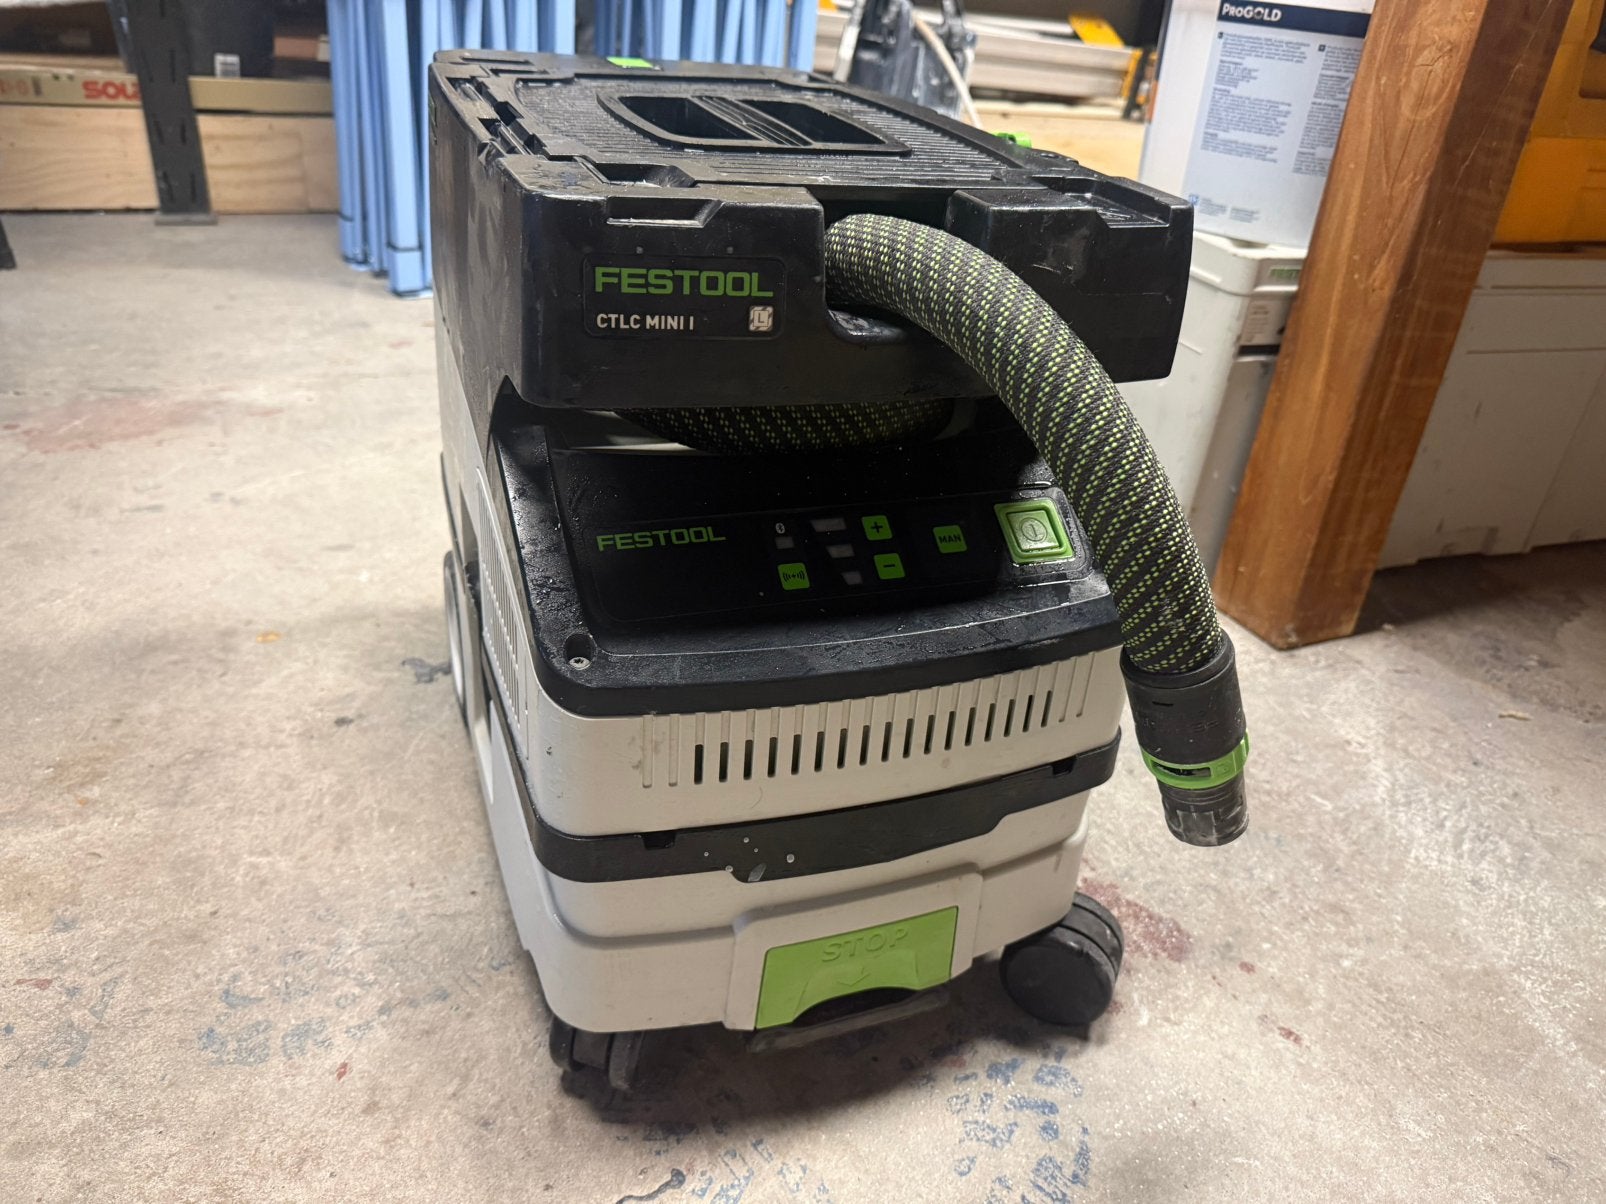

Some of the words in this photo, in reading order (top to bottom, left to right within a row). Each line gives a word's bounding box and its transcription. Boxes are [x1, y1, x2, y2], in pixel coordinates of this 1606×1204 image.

[595, 266, 774, 297] FESTOOL
[596, 313, 641, 329] CTLC
[645, 314, 684, 330] MINI
[596, 526, 726, 551] FESTOOL
[938, 532, 963, 545] MAN
[821, 928, 908, 963] STOP
